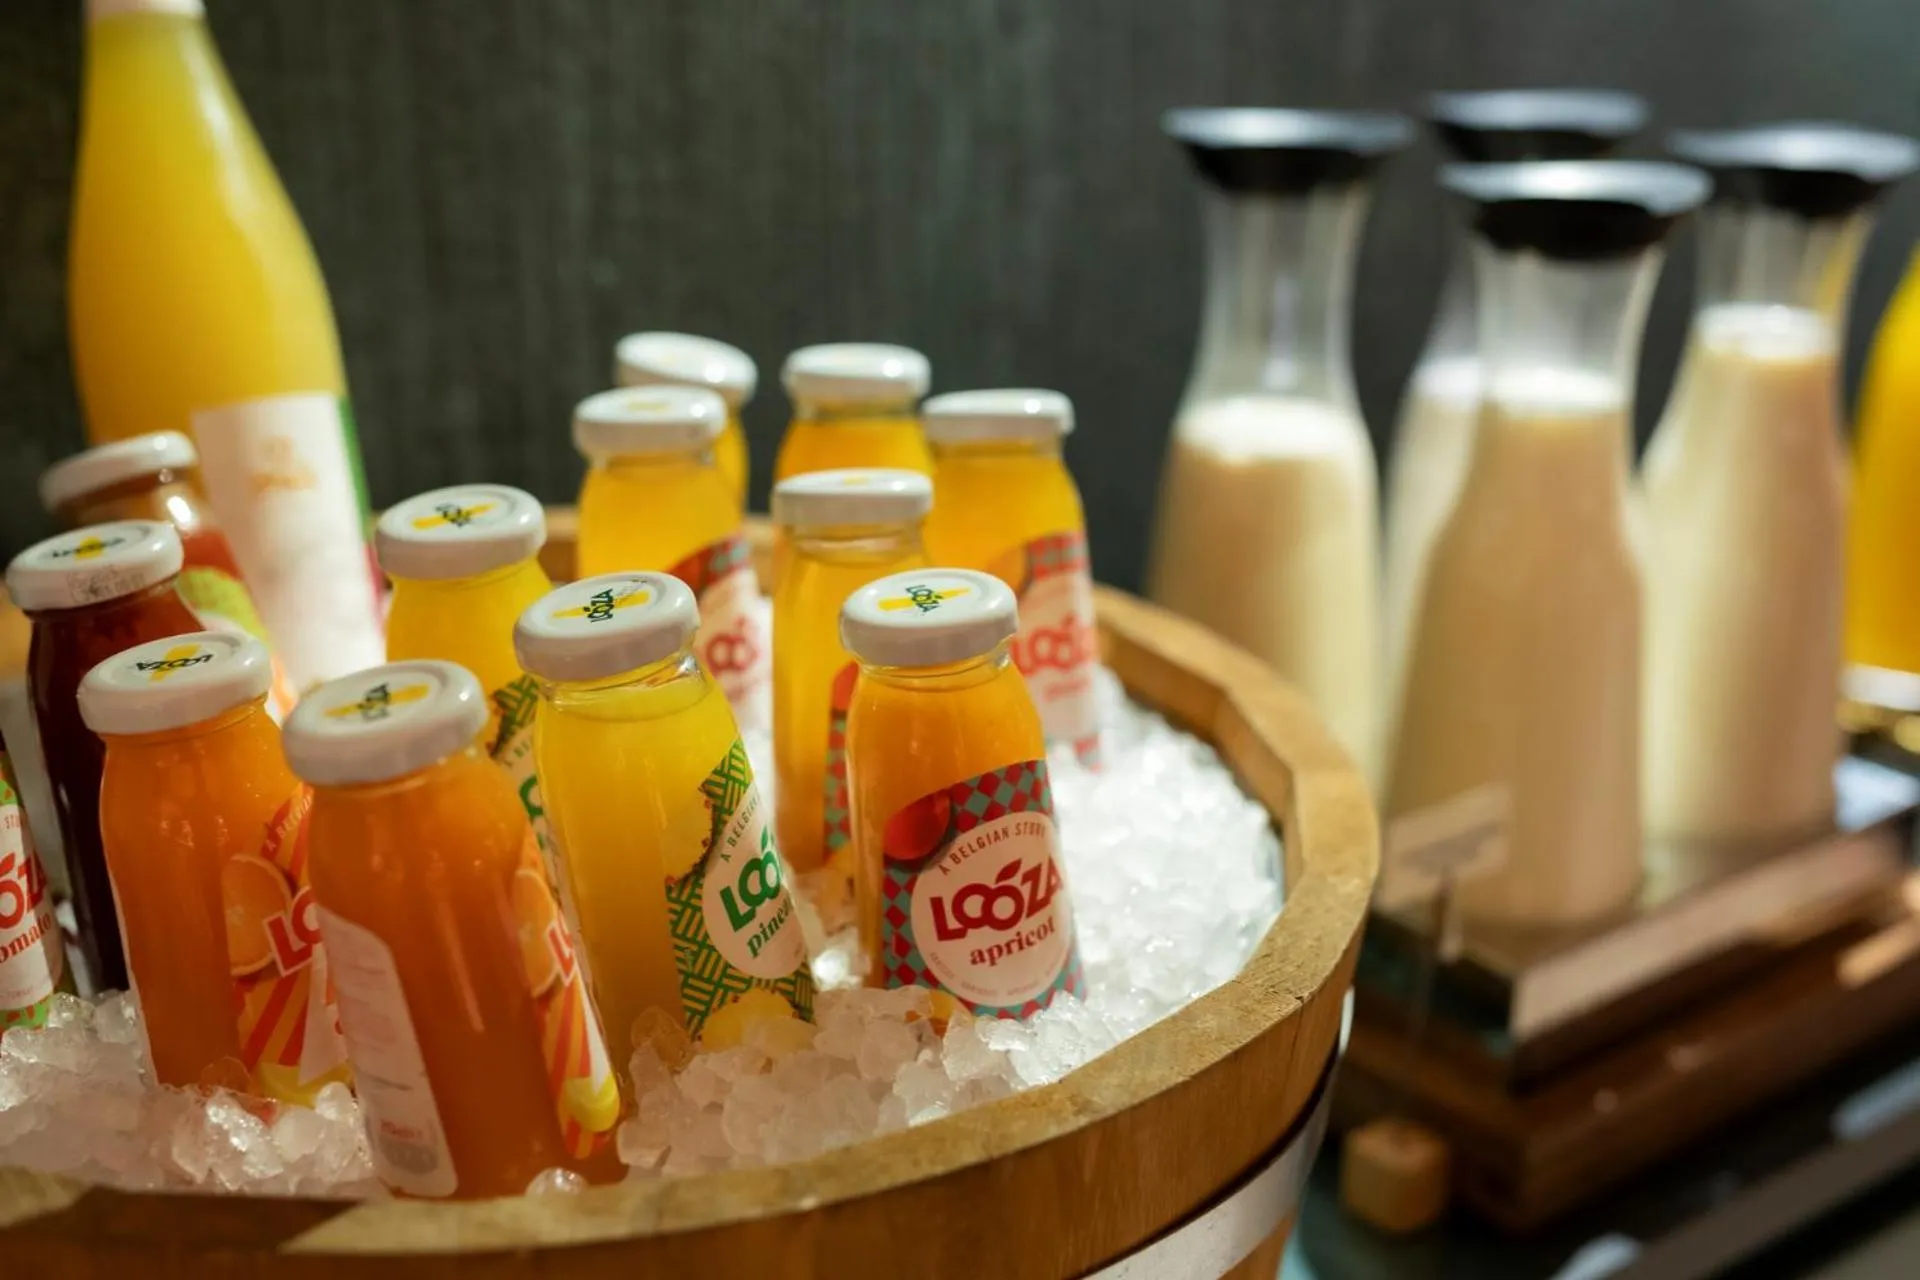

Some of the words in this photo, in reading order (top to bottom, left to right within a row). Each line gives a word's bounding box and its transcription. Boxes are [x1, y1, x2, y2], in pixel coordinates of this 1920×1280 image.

[938, 863, 951, 877] A
[950, 827, 1010, 865] BELGIAN
[969, 915, 1056, 967] apricot
